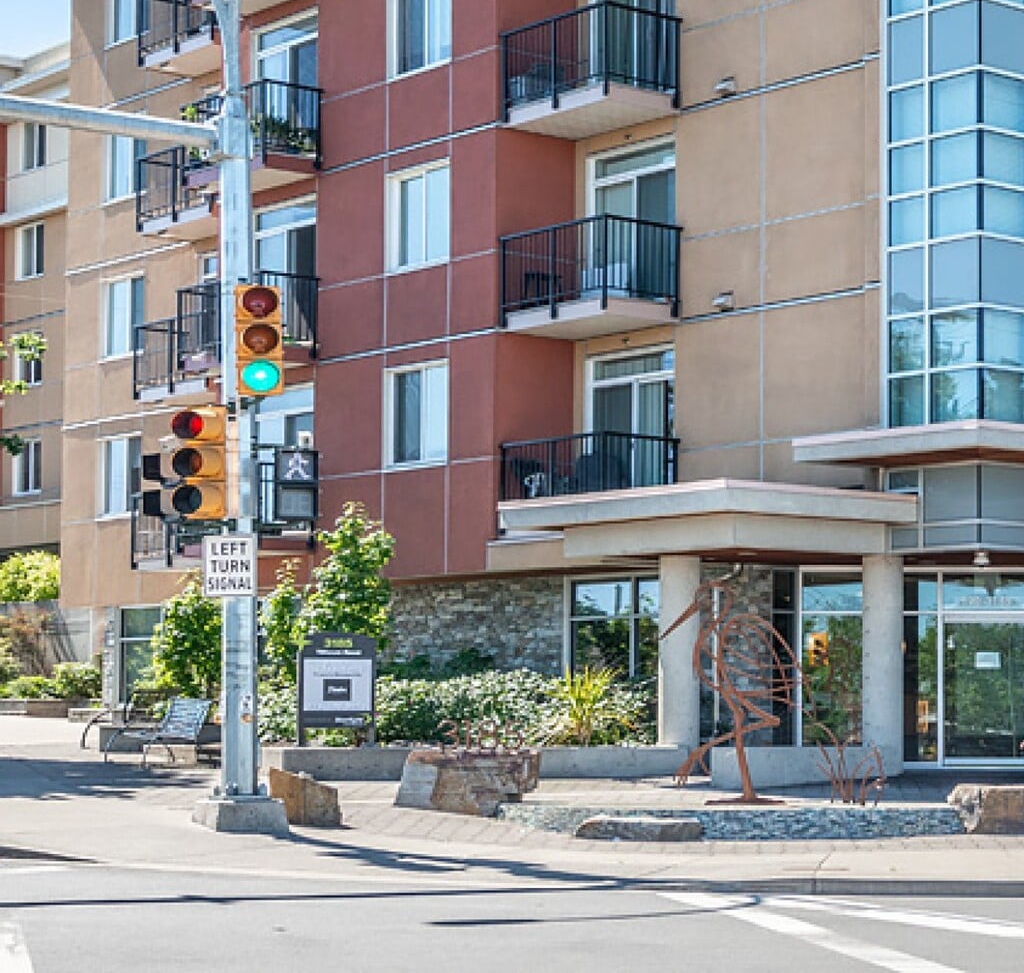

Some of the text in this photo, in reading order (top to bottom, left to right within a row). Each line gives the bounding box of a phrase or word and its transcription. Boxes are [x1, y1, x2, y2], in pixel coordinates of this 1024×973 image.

[210, 541, 249, 556] LEFT
[210, 559, 251, 573] TURN
[208, 576, 251, 590] SIGNAL
[437, 719, 524, 751] 3185
